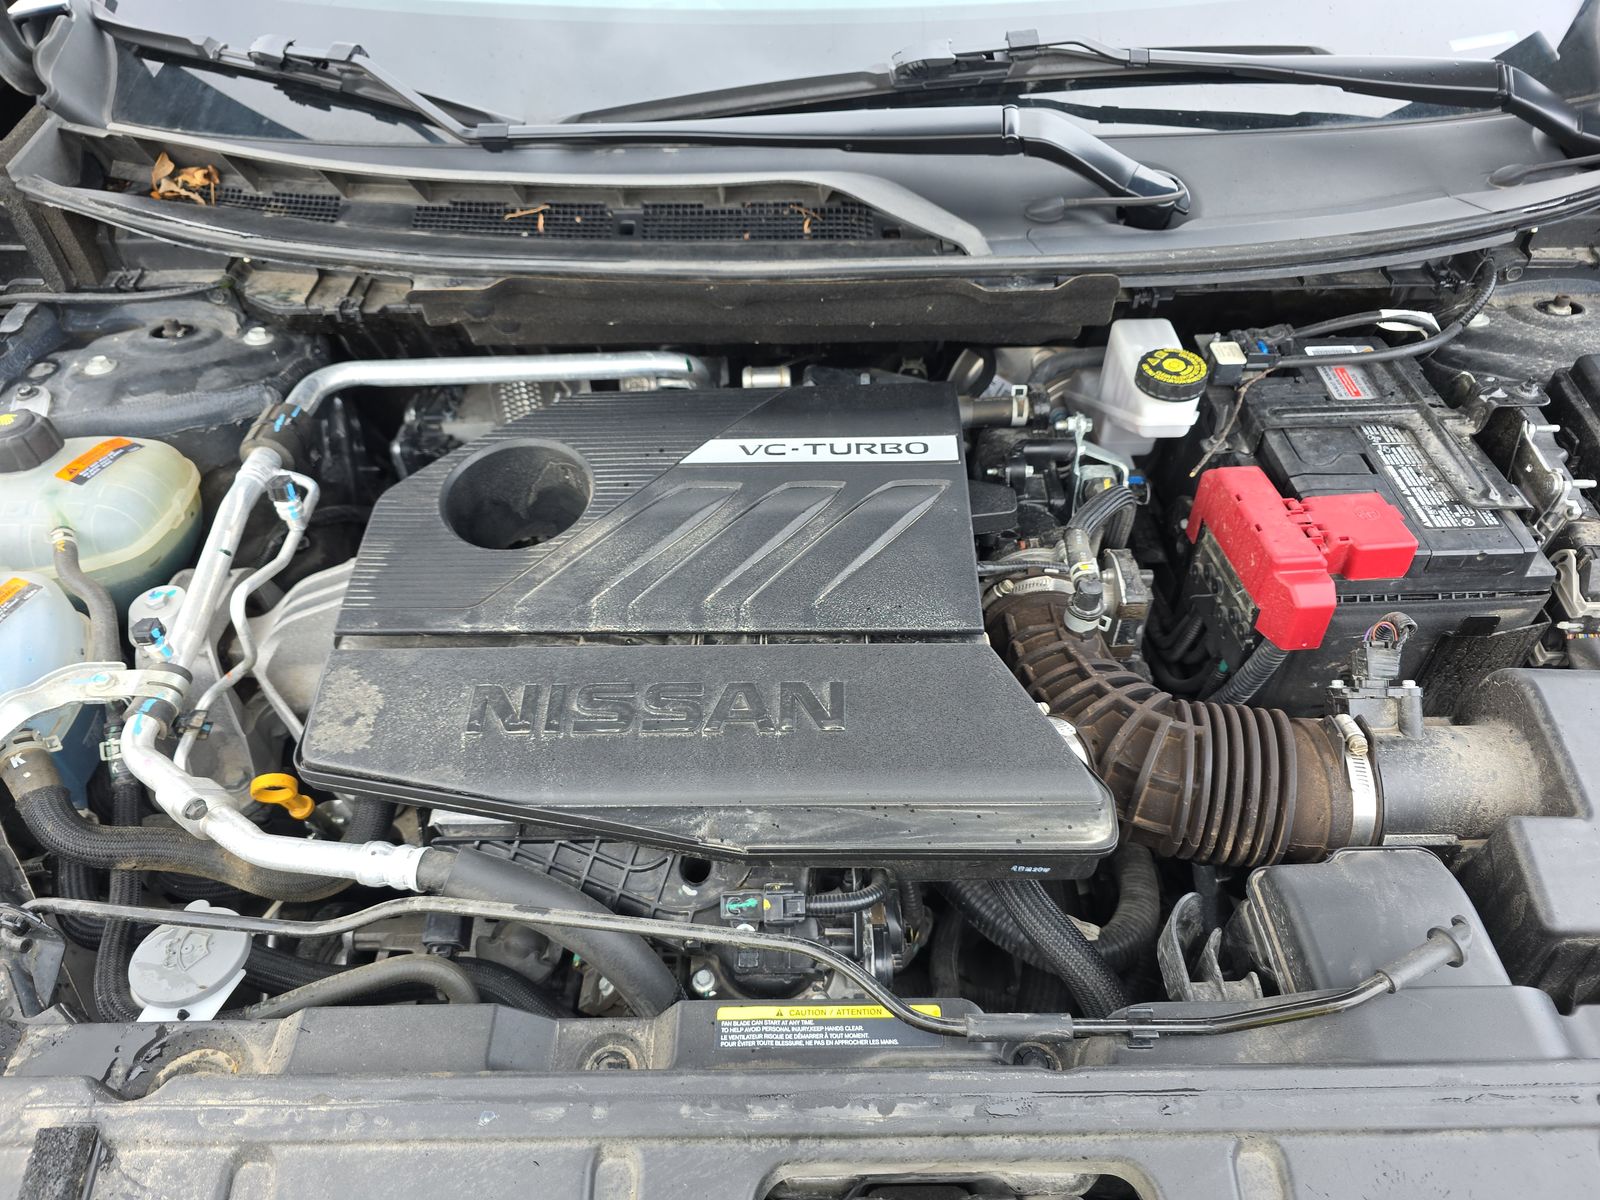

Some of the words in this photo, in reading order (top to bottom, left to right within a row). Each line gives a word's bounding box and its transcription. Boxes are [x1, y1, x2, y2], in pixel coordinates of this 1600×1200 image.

[739, 442, 929, 456] VC-TURBO
[465, 681, 846, 736] NISSAN
[10, 753, 26, 768] K
[789, 1009, 827, 1017] CAUTION
[836, 1008, 882, 1016] ATTENTION
